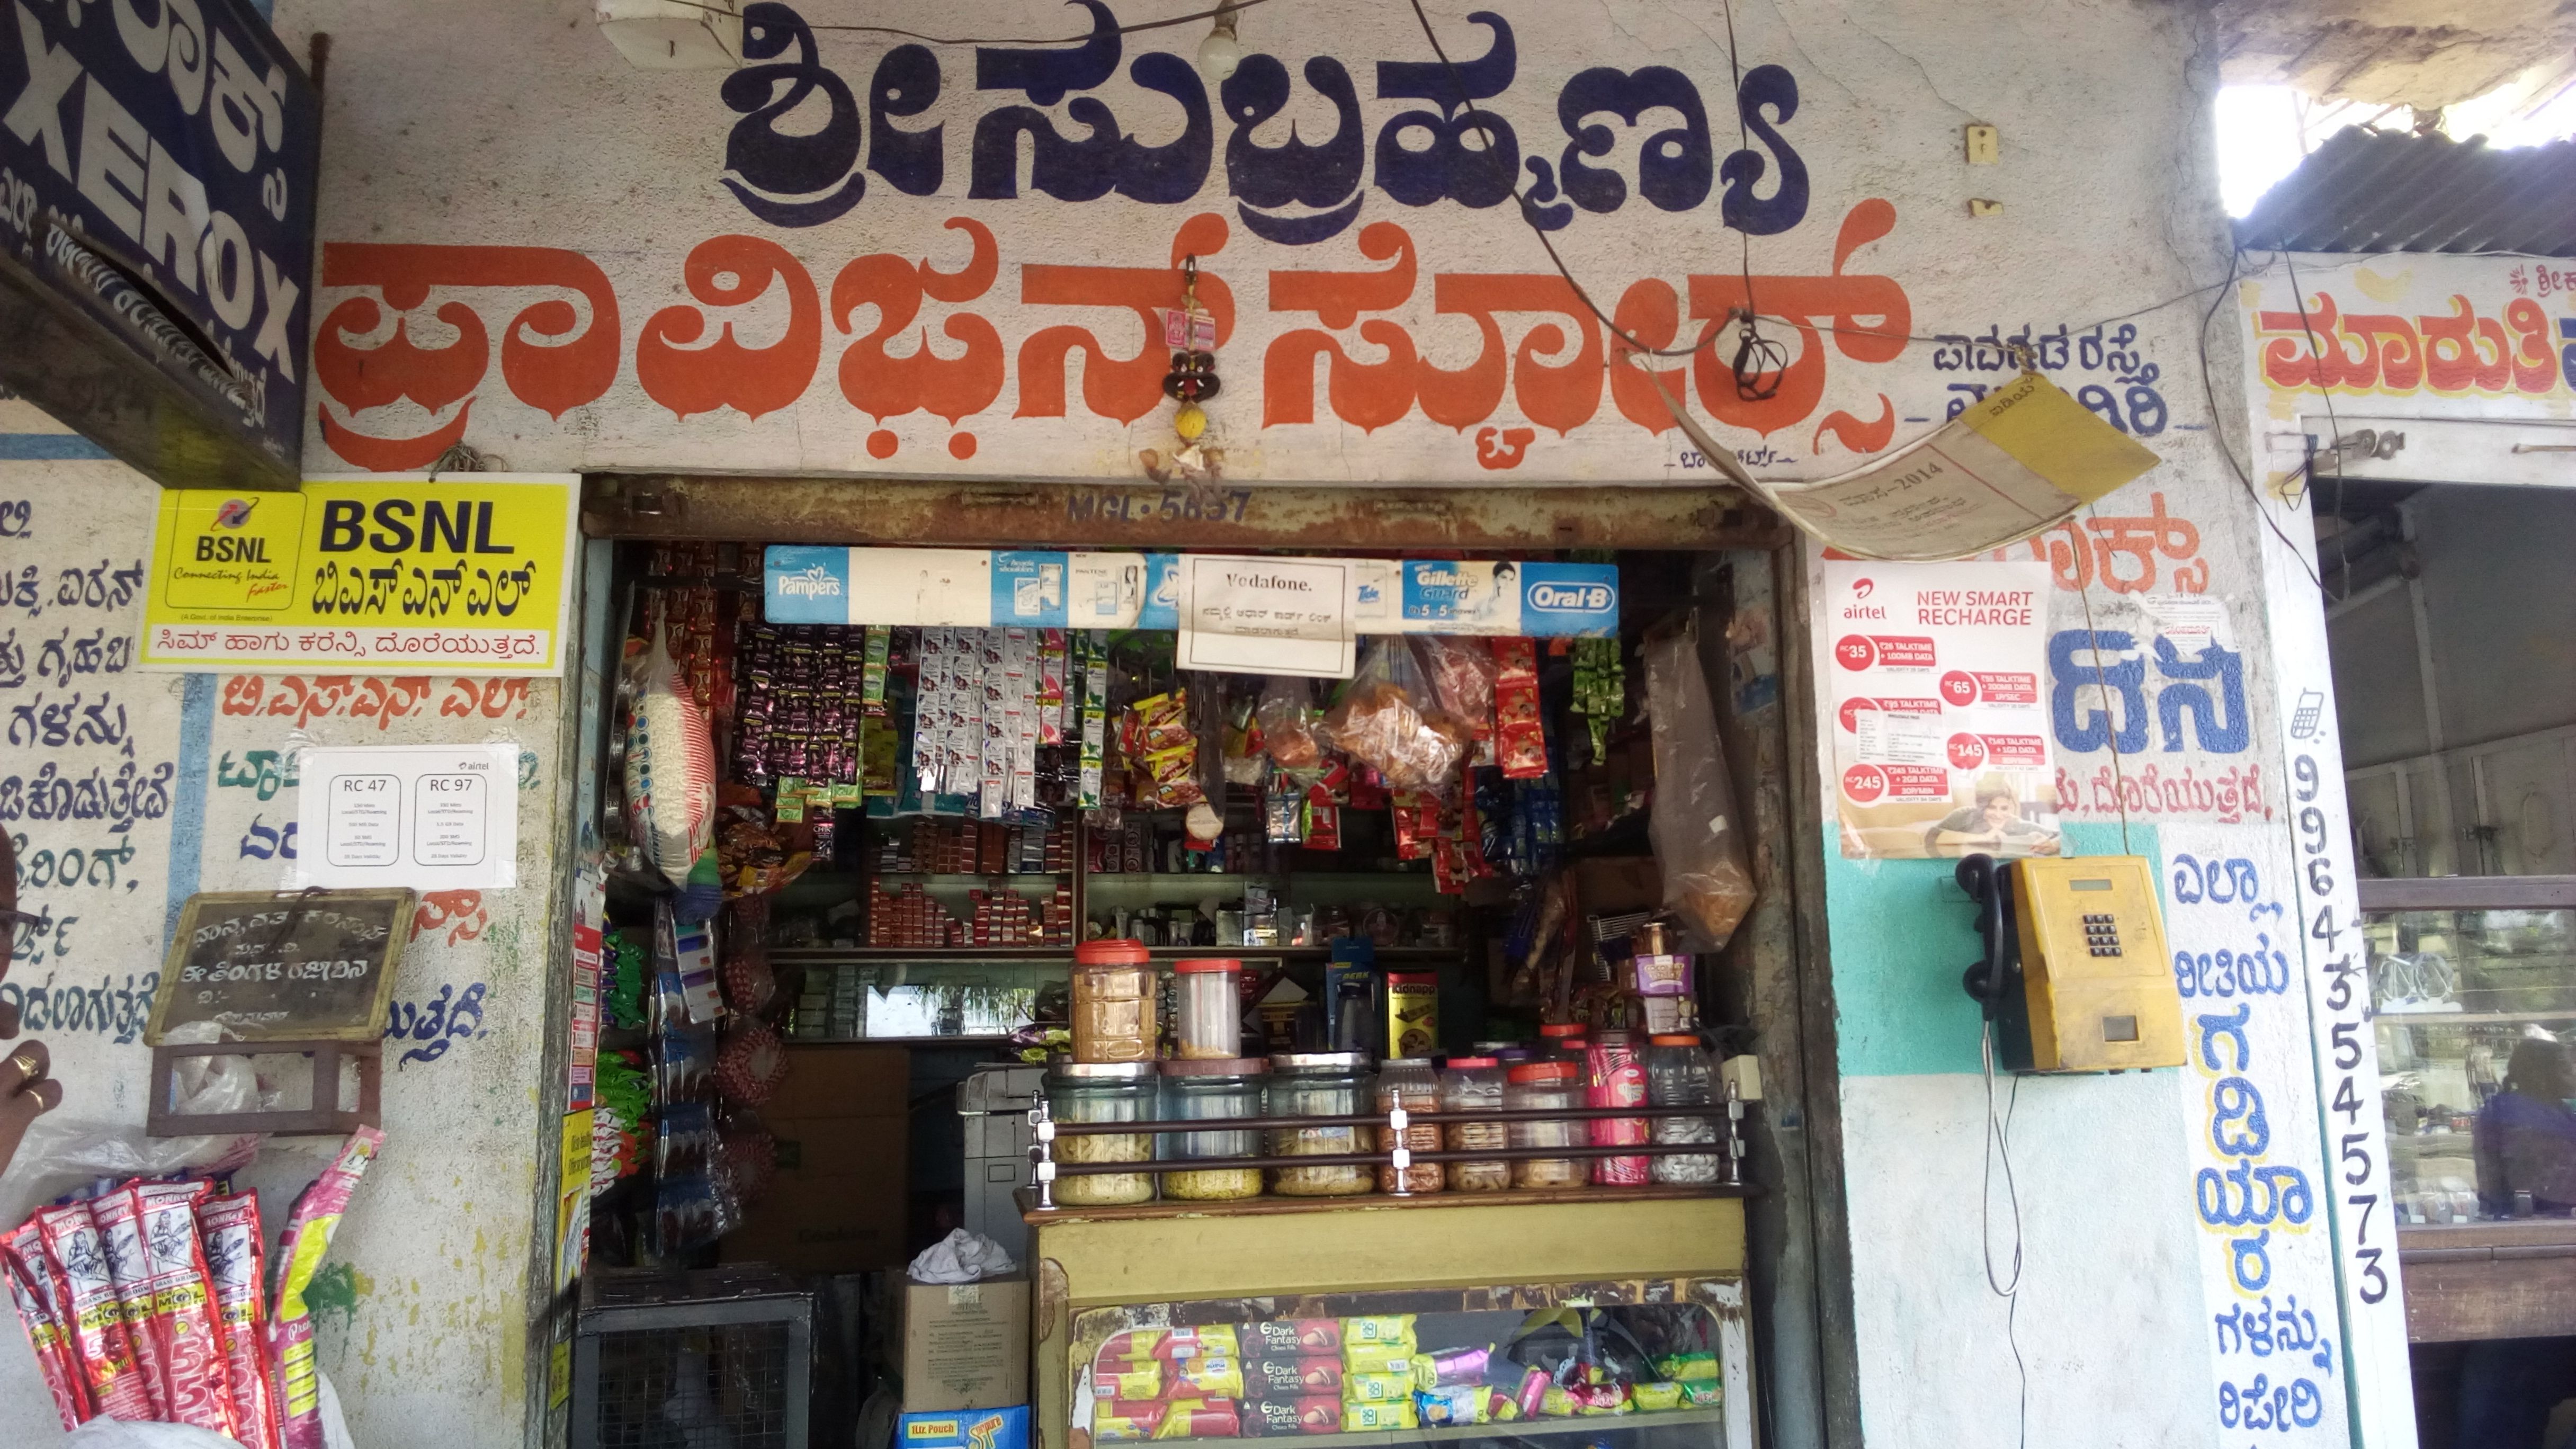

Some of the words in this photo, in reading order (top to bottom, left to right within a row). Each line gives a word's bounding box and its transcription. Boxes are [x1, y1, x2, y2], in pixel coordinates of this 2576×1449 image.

[2, 0, 300, 385] XEROX
[2256, 291, 2558, 397] ಮಾರುತಿ
[319, 499, 514, 554] BSNL
[196, 536, 272, 563] BSNL
[174, 567, 242, 582] Connecting
[246, 570, 280, 580] India
[1417, 570, 1479, 586] Gillette
[779, 577, 840, 600] Pampers
[1421, 586, 1470, 600] Guard
[1534, 586, 1611, 609] Oral-B
[1917, 591, 1960, 605] NEW
[1965, 591, 2034, 606] SMART
[1844, 604, 1886, 619] airtel
[1918, 609, 2032, 625] RECHARGE
[157, 629, 217, 650] ಸಿಮ್
[225, 632, 290, 651] ಹಾಗು
[299, 630, 366, 657] ಕರೆನ್ಸಿ
[1895, 643, 1933, 651] TALKTIME
[1849, 645, 1867, 658] 35
[1953, 681, 1971, 694] 65
[1958, 744, 1983, 757] 145
[344, 780, 364, 792] RC
[368, 780, 387, 792] 47
[431, 780, 450, 791] RC
[454, 779, 472, 791] 97
[1854, 776, 1881, 789] 245
[1272, 1326, 1295, 1335] Dark
[1265, 1336, 1302, 1346] Fantasy
[1275, 1366, 1298, 1375] Dark
[1268, 1375, 1305, 1385] Fantasy
[1273, 1405, 1296, 1414] Dark
[1266, 1415, 1303, 1425] Fantasy
[928, 1424, 954, 1434] Pouch
